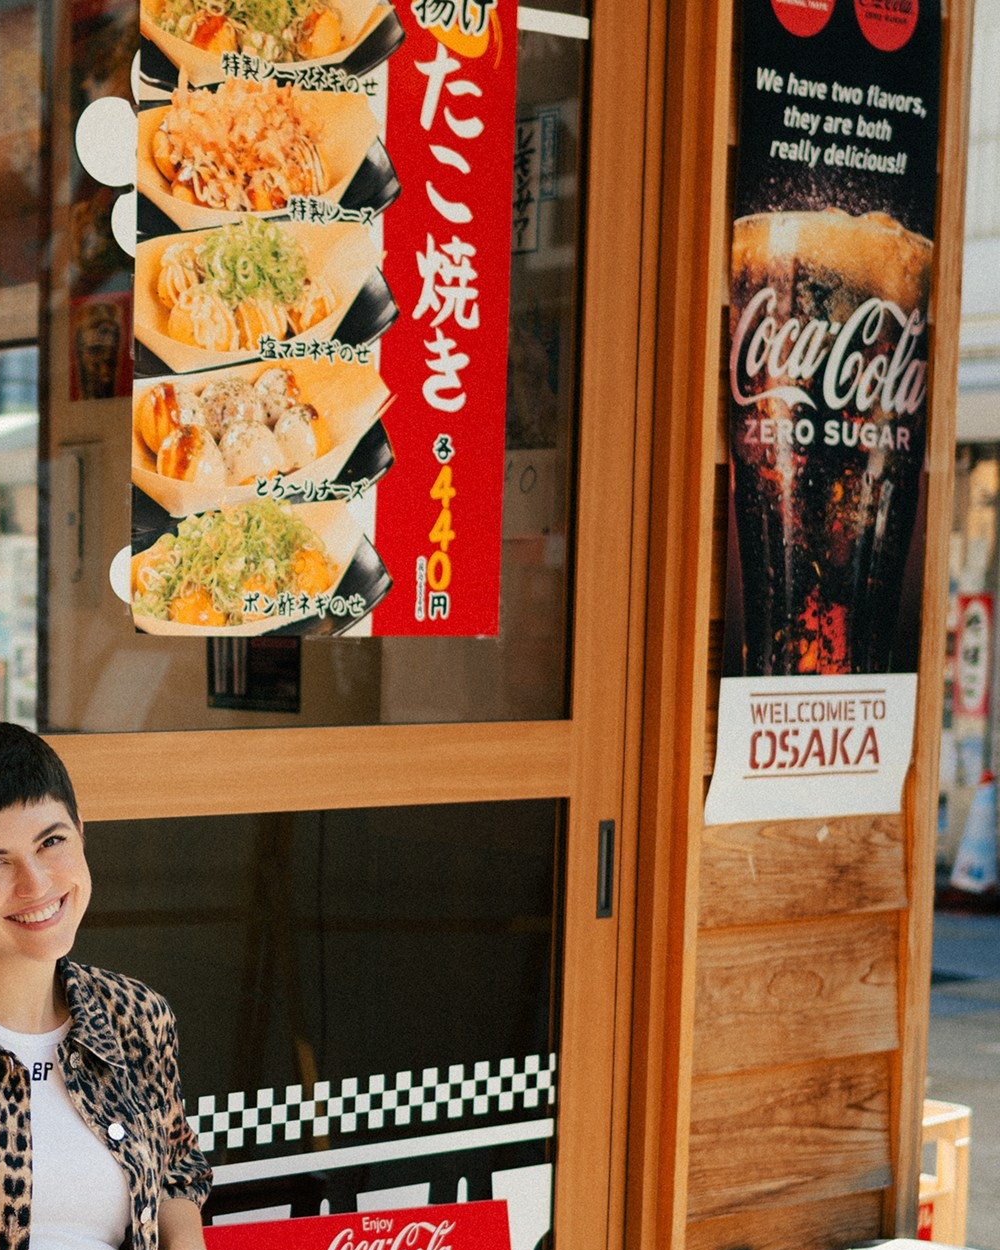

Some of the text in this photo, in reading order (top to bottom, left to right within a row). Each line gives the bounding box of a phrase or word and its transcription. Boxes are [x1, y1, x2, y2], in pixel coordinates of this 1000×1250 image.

[222, 53, 379, 97] 特製ソースネギのせ
[757, 67, 926, 118] We have two flavors,
[783, 106, 892, 141] they are both
[770, 139, 907, 175] really delicious!!
[289, 199, 375, 226] 特製ソース
[412, 41, 485, 412] たこ焼き
[259, 335, 371, 364] 塩マヨネギのせ
[730, 287, 928, 414] Coca-Cola
[744, 419, 910, 452] ZERO SUGAR
[243, 593, 365, 618] ポン酢ネギのせ
[750, 699, 886, 725] WELCOME TO
[748, 726, 881, 770] OSAKA
[362, 1216, 393, 1233] Enjoy
